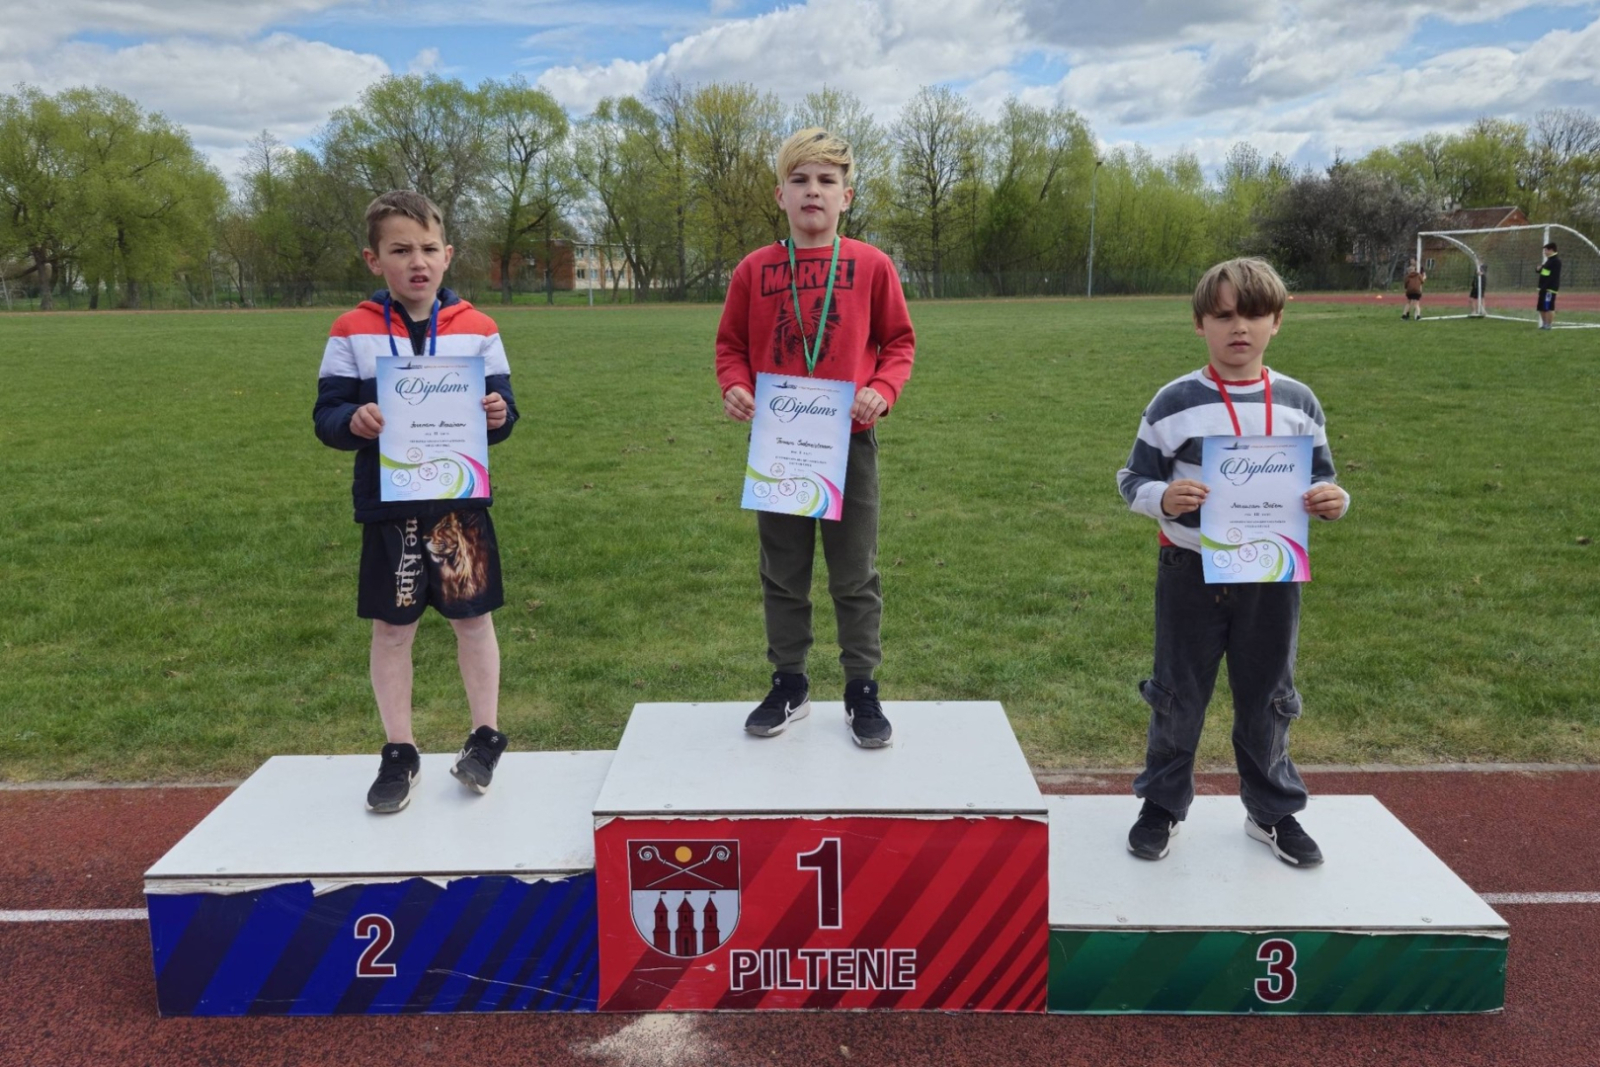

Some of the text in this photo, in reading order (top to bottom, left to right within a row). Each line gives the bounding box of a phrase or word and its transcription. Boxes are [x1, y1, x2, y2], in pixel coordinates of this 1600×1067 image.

[763, 260, 852, 294] MARVEL
[395, 371, 469, 406] Diploms
[769, 394, 838, 424] Diploms
[1220, 451, 1295, 487] Diploms
[797, 837, 842, 929] 1
[354, 913, 397, 977] 2
[729, 948, 916, 991] PILTENE
[1254, 938, 1297, 1003] 3
